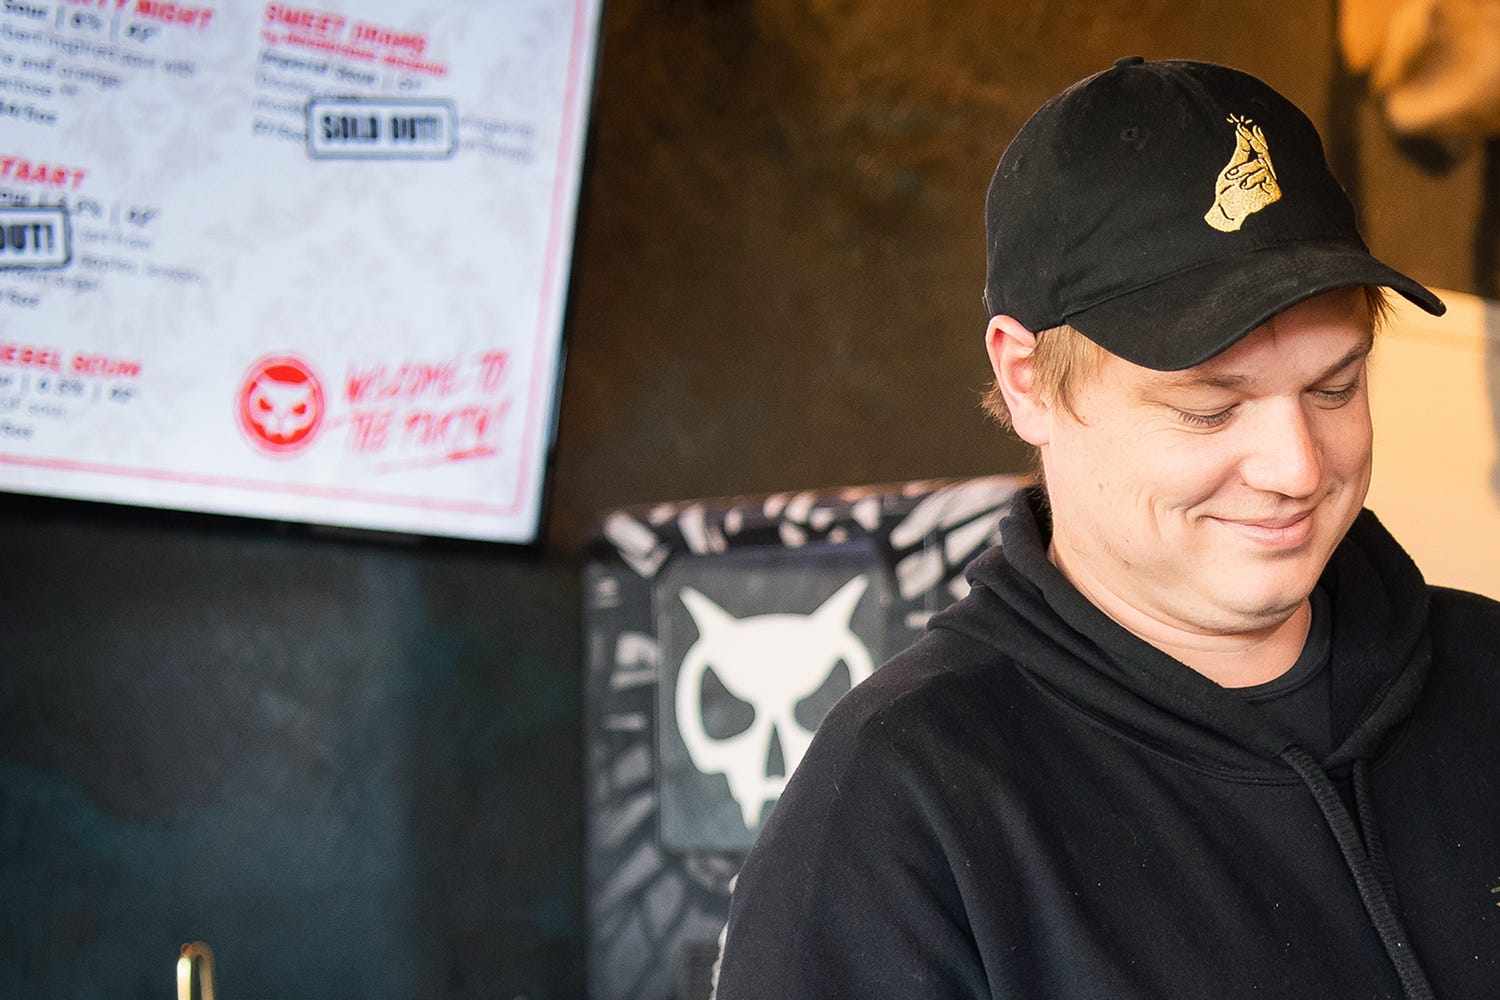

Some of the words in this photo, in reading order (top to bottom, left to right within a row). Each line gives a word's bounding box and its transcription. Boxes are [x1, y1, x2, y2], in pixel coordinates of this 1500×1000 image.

[264, 4, 345, 32] SWEET
[322, 115, 379, 141] SOLD
[0, 222, 54, 251] UT!
[0, 346, 61, 372] EBEL
